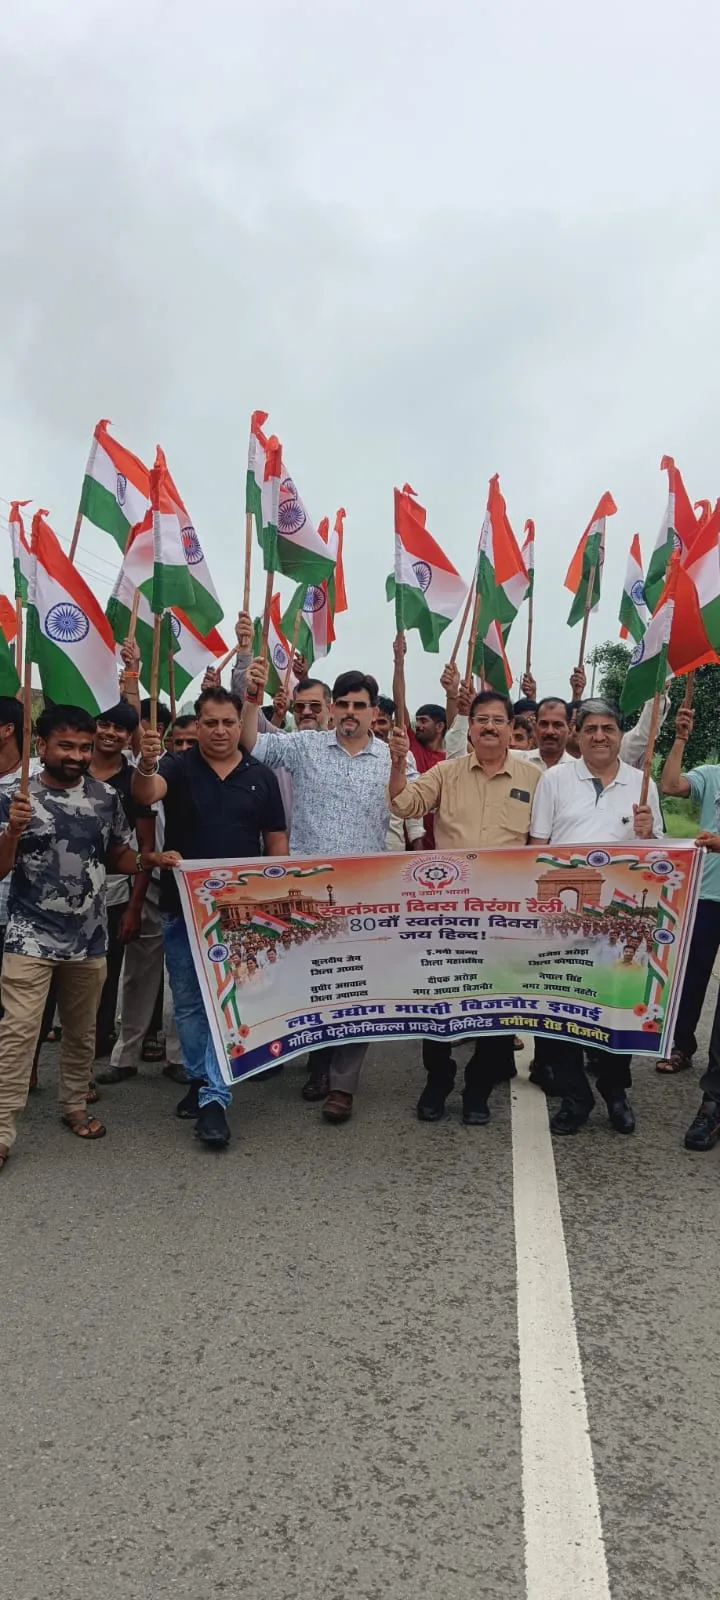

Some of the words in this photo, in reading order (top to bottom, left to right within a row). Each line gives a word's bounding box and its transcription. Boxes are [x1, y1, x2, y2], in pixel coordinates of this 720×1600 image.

[318, 902, 400, 916] स्वतंत्रता
[406, 899, 458, 912] दिवस
[464, 898, 520, 912] तिरंगा
[525, 897, 563, 913] रैली
[405, 914, 480, 927] स्वतंत्रता
[488, 915, 540, 929] दिवस
[398, 930, 432, 940] जय
[438, 928, 486, 940] हिन्द!
[311, 956, 343, 966] कुलदीप
[420, 958, 443, 967] जिला
[445, 957, 484, 965] महासचिव
[554, 957, 594, 967] कोषाध्यक्ष
[310, 968, 333, 976] जिला
[336, 965, 364, 973] अध्यक्ष
[427, 976, 451, 984] दीपक
[539, 972, 564, 980] नेपाल
[433, 986, 460, 995] अध्यक्ष
[462, 982, 493, 992] बिजनौर
[544, 984, 571, 992] अध्यक्ष
[310, 994, 333, 1003] जिला
[285, 1012, 324, 1029] लघु
[329, 1004, 386, 1019] उद्योग
[394, 1002, 452, 1015] भारती
[459, 996, 539, 1011] बिजनौर
[546, 1000, 602, 1021] इकाई
[288, 1030, 323, 1048] मोहित
[326, 1021, 406, 1038] पेट्रोकेमिकल्स
[408, 1019, 445, 1033] प्राइवेट
[449, 1016, 493, 1031] लिमिटेड
[499, 1015, 538, 1028] नगीना
[542, 1017, 562, 1031] रोड
[566, 1021, 610, 1043] बिजनौर
